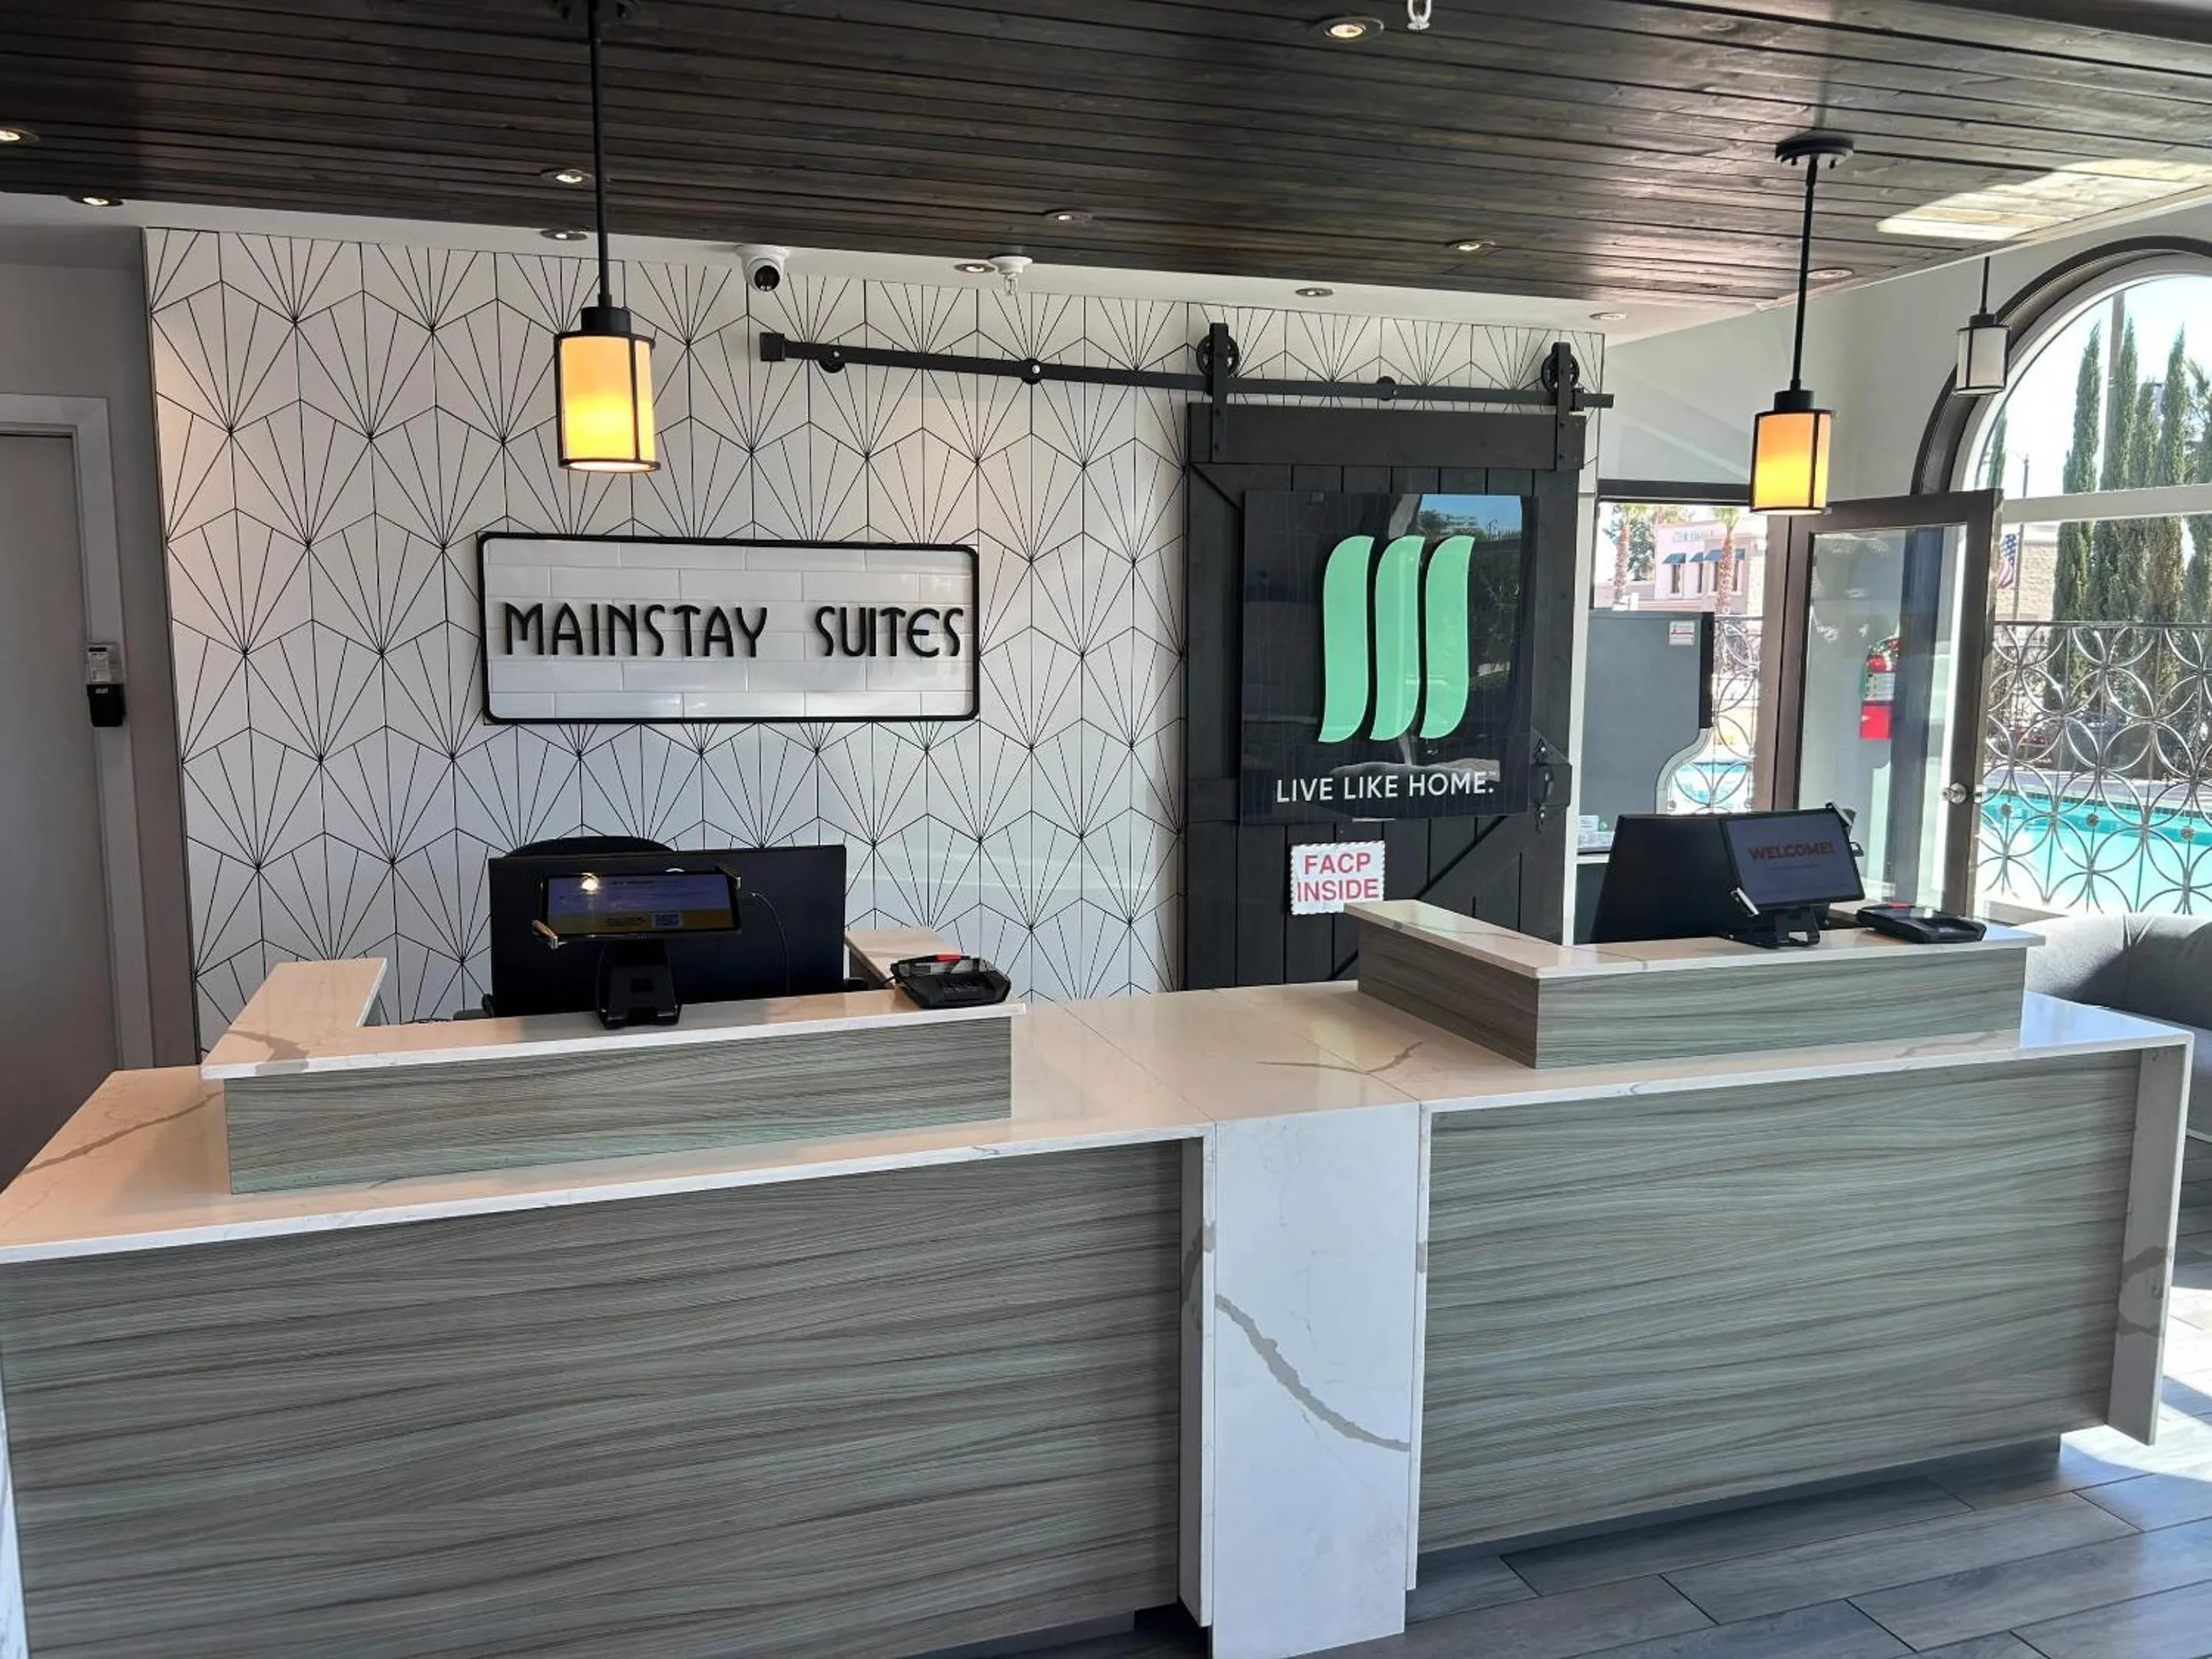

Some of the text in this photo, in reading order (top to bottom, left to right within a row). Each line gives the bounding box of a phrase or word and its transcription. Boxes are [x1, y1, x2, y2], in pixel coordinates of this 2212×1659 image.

[504, 602, 964, 658] MAINSTAY SUITES
[1277, 777, 1333, 803] LIVE
[1344, 774, 1399, 800] LIKE
[1748, 840, 1834, 860] WELCOME!
[1304, 852, 1372, 876] FACP
[1296, 878, 1379, 902] INSIDE
